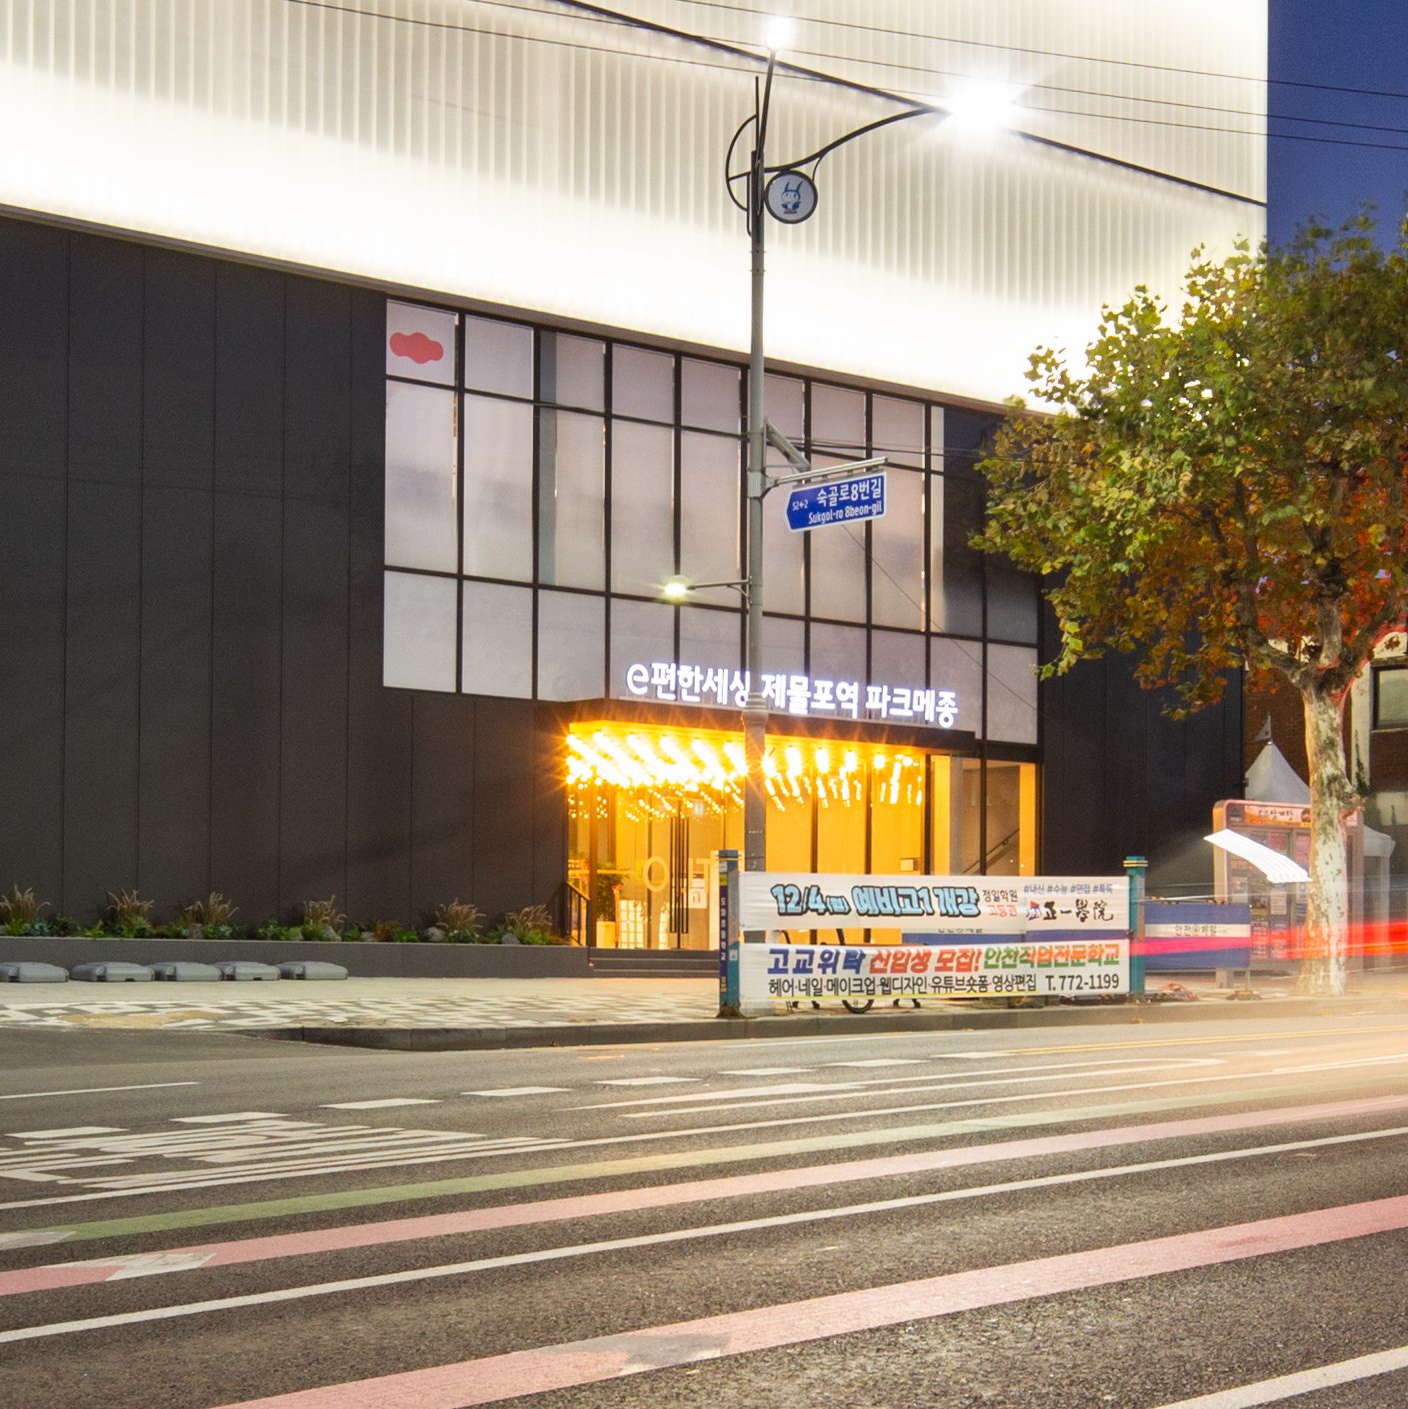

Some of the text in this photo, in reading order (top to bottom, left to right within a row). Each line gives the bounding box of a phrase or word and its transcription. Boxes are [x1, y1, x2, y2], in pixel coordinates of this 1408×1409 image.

[816, 477, 882, 508] 숙골로8번길
[808, 501, 882, 525] Sukgol-ro 8beon-gil
[761, 673, 859, 719] 제물포역
[866, 684, 959, 728] 파크메종
[851, 885, 935, 917] 예비고1
[933, 886, 981, 918] 개강
[982, 889, 1018, 903] 정일학원
[1023, 884, 1045, 895] #내신
[1047, 884, 1068, 895] #수능
[767, 943, 1120, 975] 고교위탁 신입생 모집! 인천직업전문학교
